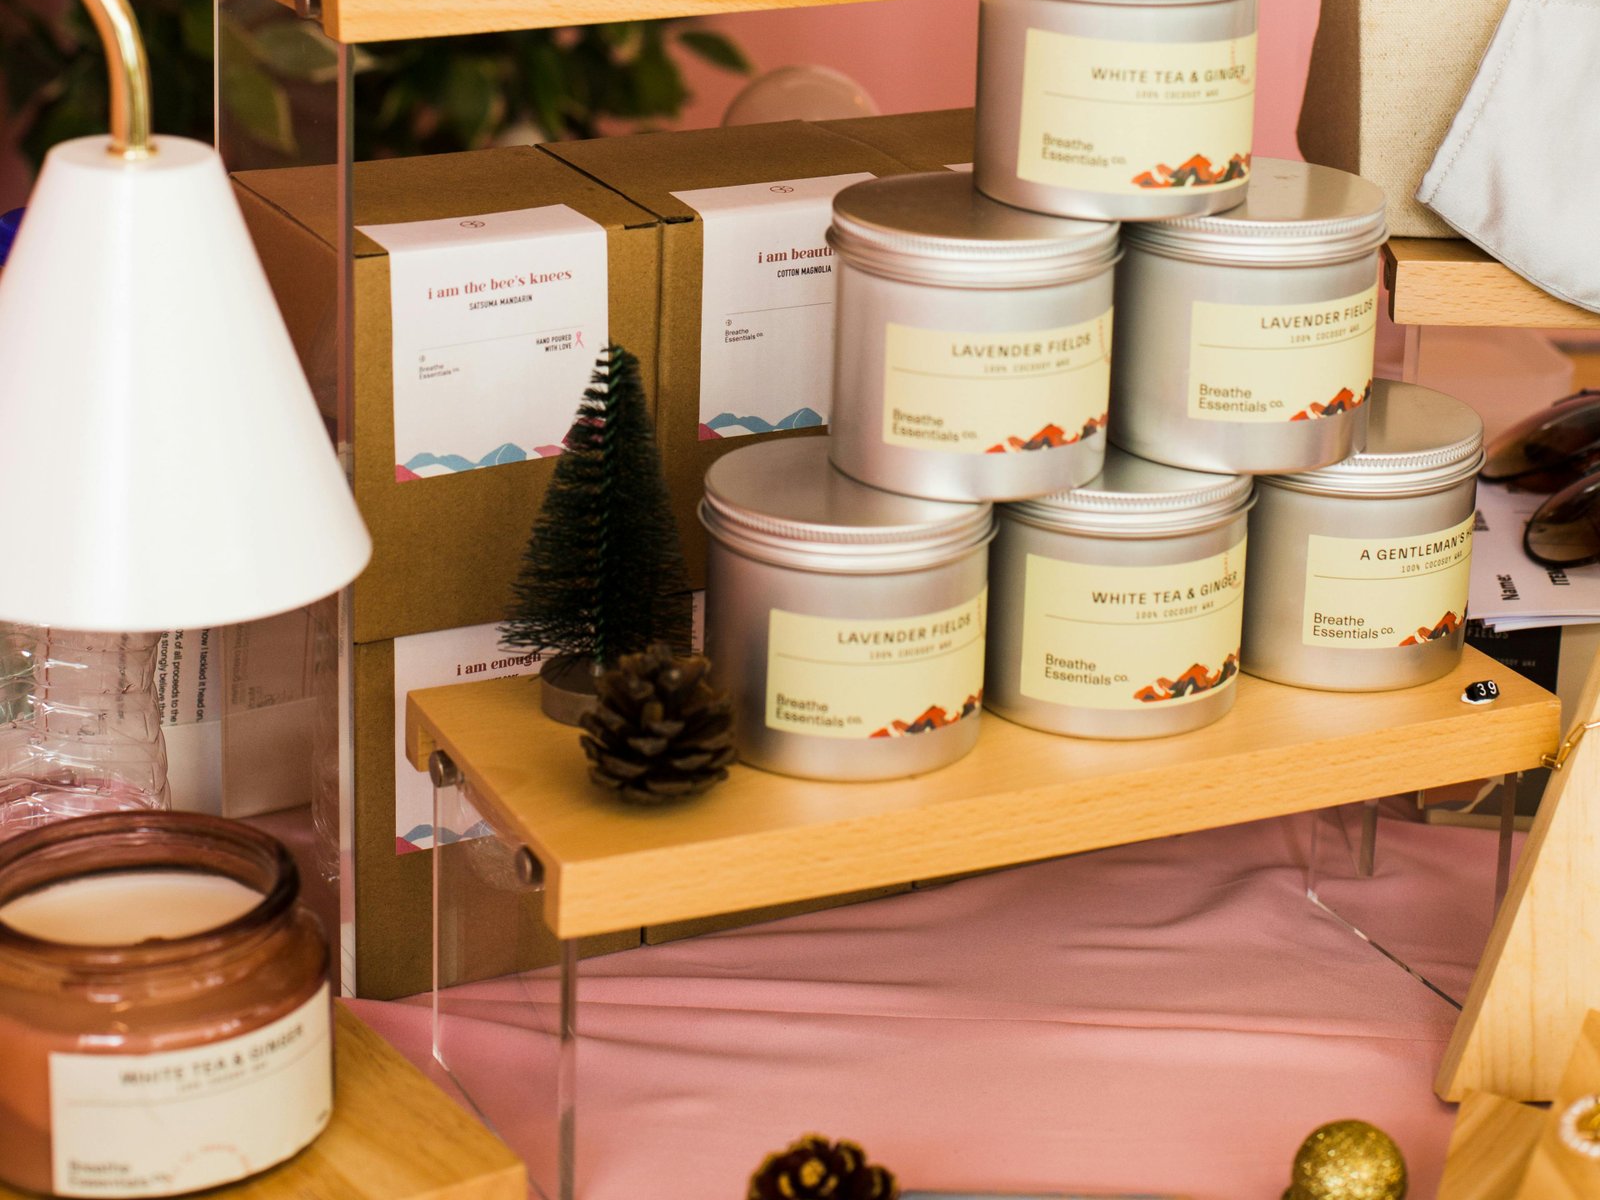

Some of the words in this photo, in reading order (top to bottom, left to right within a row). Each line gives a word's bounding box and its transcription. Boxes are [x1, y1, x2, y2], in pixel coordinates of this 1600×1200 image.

[1092, 67, 1147, 83] WHITE
[1155, 72, 1184, 83] TEA
[1190, 72, 1198, 83] &
[1204, 64, 1246, 82] GINGER
[1042, 133, 1093, 151] Breathe
[1042, 147, 1109, 167] Essentials
[758, 252, 762, 263] i
[766, 252, 787, 262] am
[777, 269, 800, 278] COTTON
[801, 265, 832, 275] MAGNOLIA
[428, 288, 433, 300] i
[436, 288, 459, 299] am
[464, 282, 487, 294] the
[491, 275, 526, 291] bee's
[530, 270, 572, 285] knees
[469, 300, 498, 310] SATSUMA
[500, 294, 533, 306] MANDARIN
[1261, 311, 1340, 329] LAVENDER
[1344, 299, 1373, 320] FIELDS
[551, 334, 572, 342] POURED
[725, 328, 749, 337] Breathe
[725, 335, 755, 343] Essentials
[952, 343, 1042, 358] LAVENDER
[1049, 333, 1091, 353] FIELDS
[1199, 383, 1252, 399] Breathe
[1199, 397, 1267, 412] Essentials
[893, 408, 944, 426] Breathe
[892, 422, 959, 441] Essentials
[1360, 550, 1371, 561] A
[1377, 531, 1465, 560] GENTLEMAN'S
[1092, 591, 1146, 605] WHITE
[1153, 590, 1182, 603] TEA
[1187, 588, 1195, 598] &
[1200, 571, 1238, 597] GINGER
[1496, 574, 1520, 600] Name:
[1314, 612, 1365, 626] Breathe
[838, 628, 927, 645] LAVENDER
[932, 613, 971, 637] FIELDS
[1313, 625, 1379, 639] Essentials
[1381, 627, 1395, 635] co.
[175, 642, 183, 650] of
[158, 640, 169, 672] strongly
[174, 651, 182, 660] all
[457, 665, 461, 676] i
[465, 662, 487, 674] am
[491, 652, 541, 669] enough
[1045, 653, 1097, 671] Breathe
[171, 662, 181, 699] proceeds
[1045, 667, 1112, 686] Essentials
[159, 673, 167, 702] believe
[1476, 681, 1497, 696] 39
[171, 699, 179, 708] to
[197, 688, 206, 708] head
[776, 693, 828, 712] Breathe
[170, 709, 179, 722] the
[776, 708, 844, 727] Essentials
